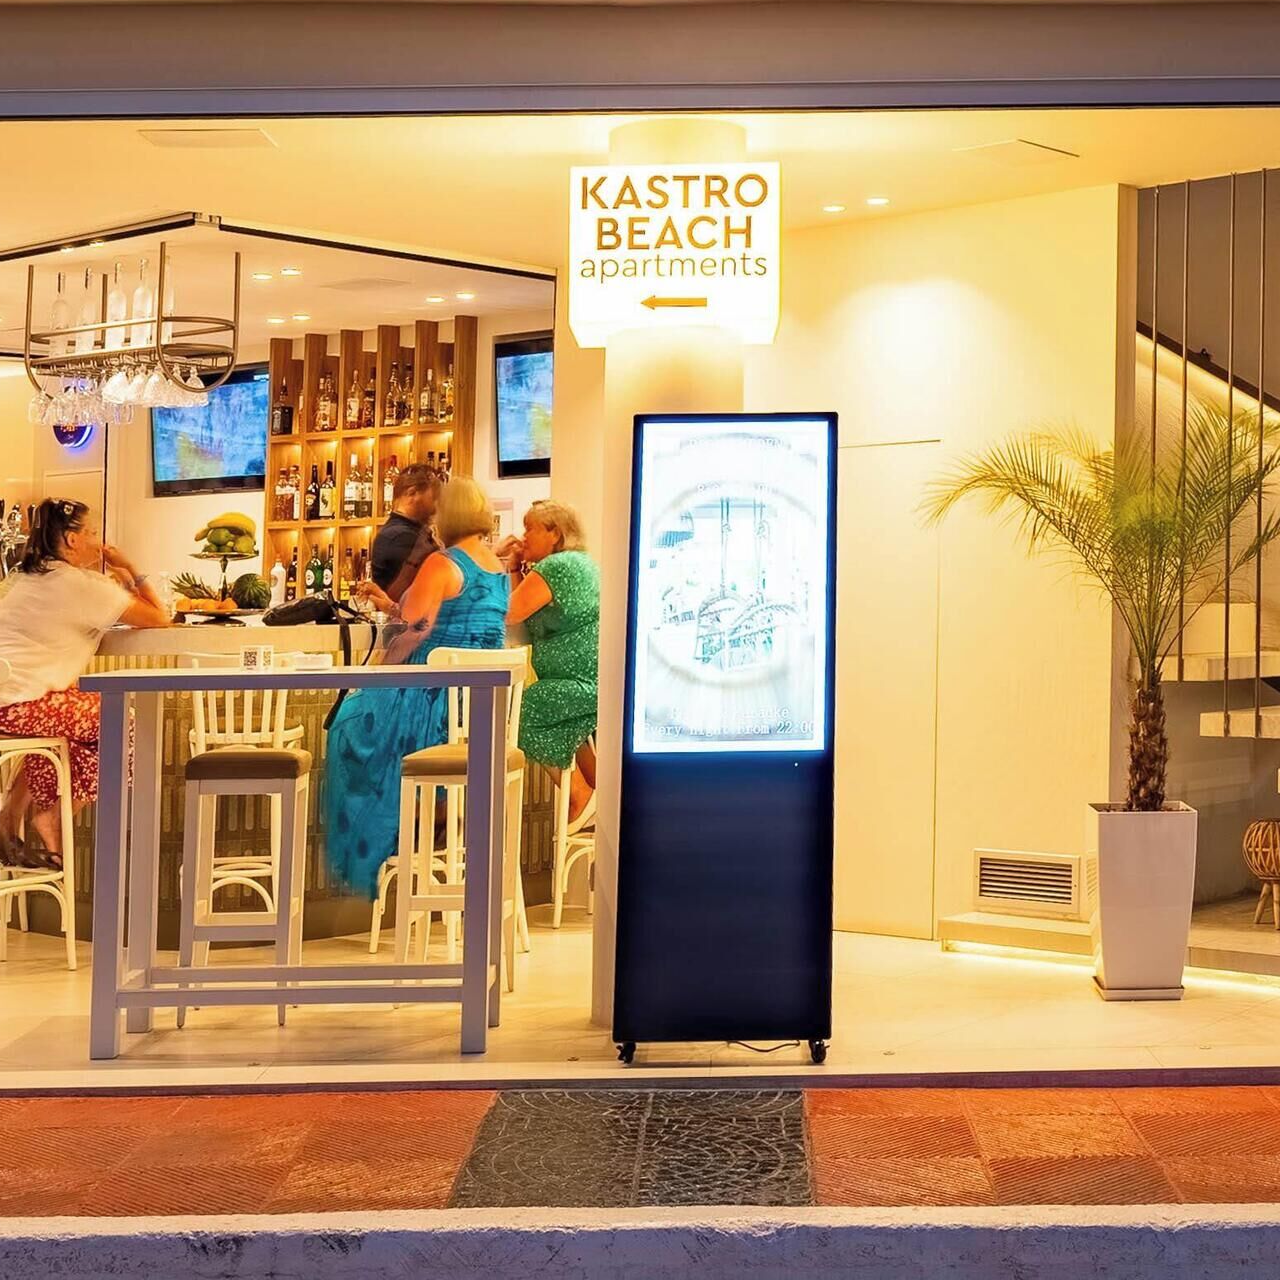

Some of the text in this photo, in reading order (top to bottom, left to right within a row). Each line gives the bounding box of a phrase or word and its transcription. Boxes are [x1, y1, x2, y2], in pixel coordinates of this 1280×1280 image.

[581, 173, 768, 210] KASTRO
[596, 215, 752, 251] BEACH
[580, 252, 768, 284] apartments
